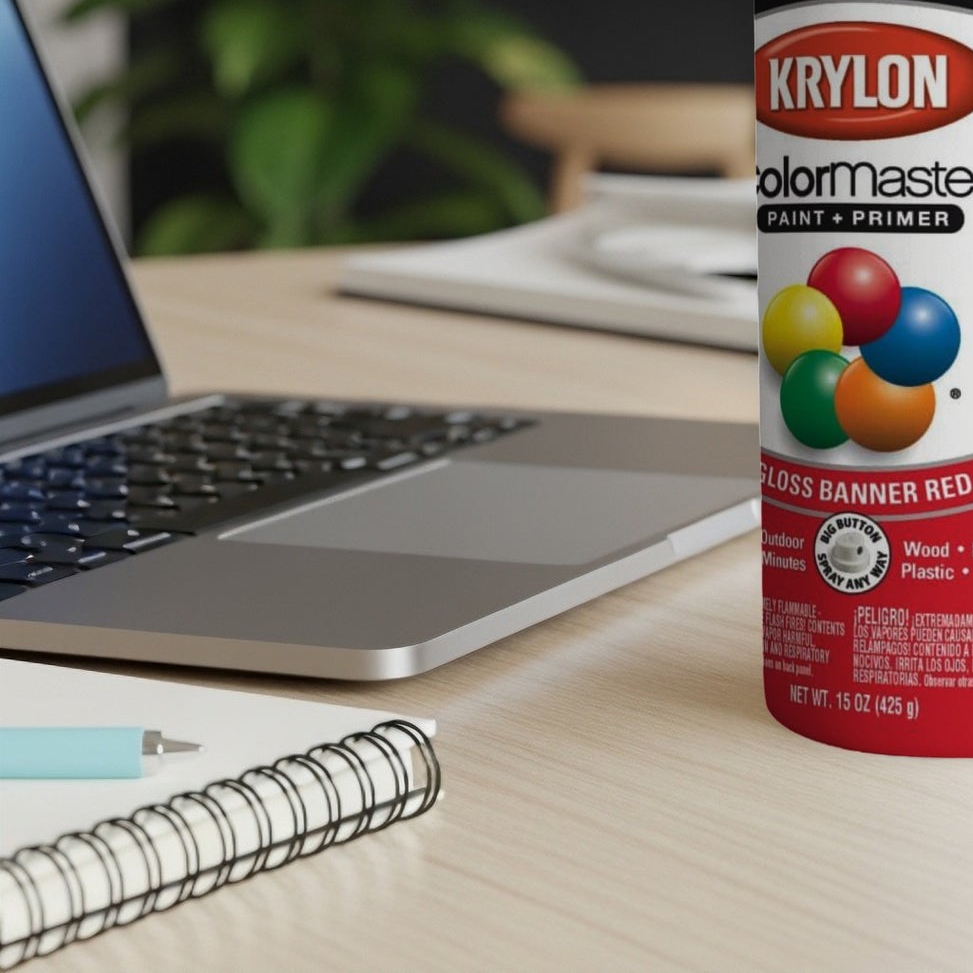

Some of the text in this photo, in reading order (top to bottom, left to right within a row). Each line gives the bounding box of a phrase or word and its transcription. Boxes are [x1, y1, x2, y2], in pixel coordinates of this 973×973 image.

[768, 54, 948, 111] KRYLON
[768, 210, 824, 226] PAINT
[852, 211, 949, 227] PRIMER
[760, 462, 973, 505] GLOSS BANNER RED
[761, 529, 805, 549] Outdoor
[820, 517, 882, 544] BIG BUTTON
[903, 540, 950, 558] Wood
[762, 551, 806, 571] Minutes
[817, 551, 888, 590] SPRAY ANY WAY
[902, 563, 954, 580] Plastic
[807, 619, 845, 636] CONTENTS
[853, 625, 869, 638] LOS
[871, 626, 908, 641] VAPORES
[910, 628, 942, 642] PUEDEN
[913, 643, 961, 657] CONTENIDO
[963, 644, 970, 657] A
[895, 657, 923, 671] IRRITA
[925, 658, 942, 672] LOS
[790, 684, 919, 719] NET WT. 15 OZ (425 g)
